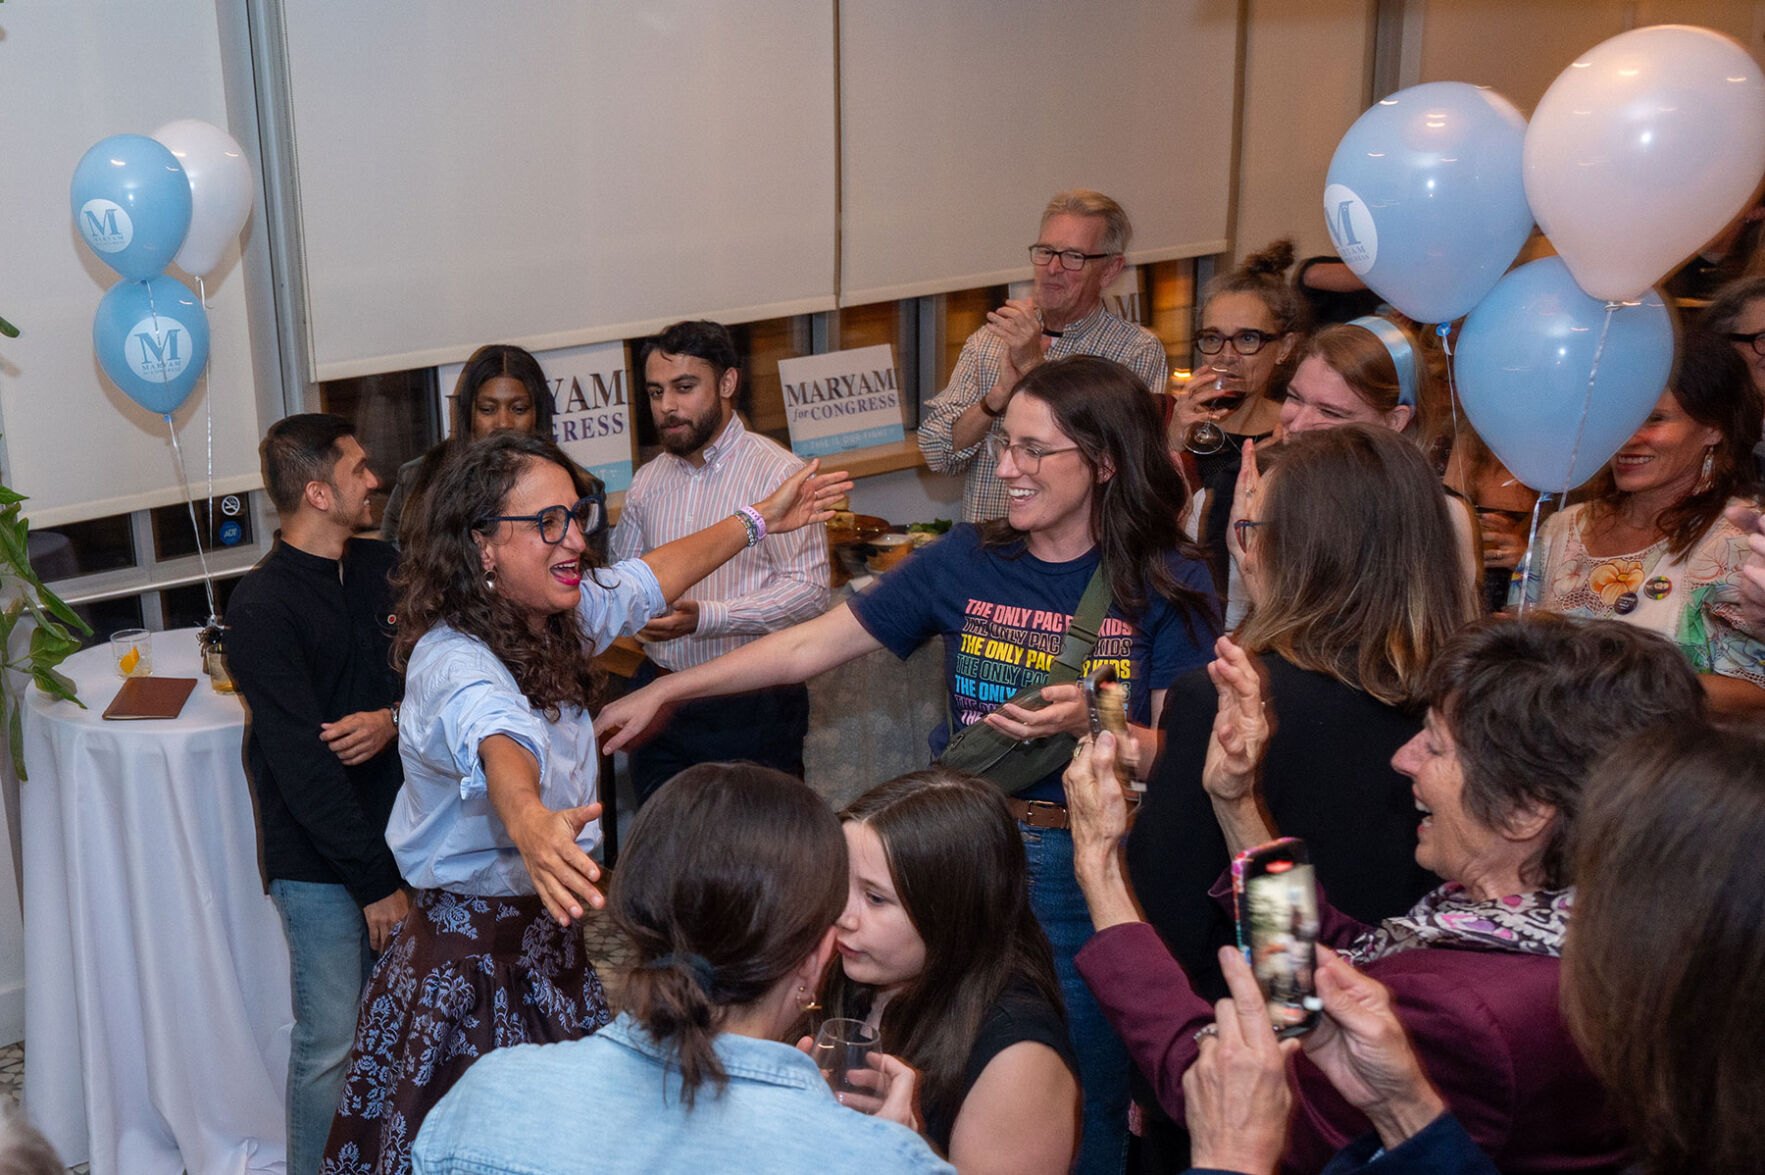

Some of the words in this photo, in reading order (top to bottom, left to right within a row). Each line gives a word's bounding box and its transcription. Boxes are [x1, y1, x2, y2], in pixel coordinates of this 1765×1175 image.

[83, 209, 121, 237] M
[134, 328, 182, 365] M
[784, 367, 896, 408] MARYAM
[792, 407, 809, 423] for
[811, 393, 897, 421] CONGRESS
[965, 598, 994, 619] THE
[992, 604, 1033, 628] ONLY
[1031, 610, 1063, 633] PAC
[960, 633, 986, 656] THE
[984, 639, 1025, 665] ONLY
[962, 616, 989, 637] THE
[989, 621, 1029, 646] ONLY
[1028, 631, 1061, 655] PAC
[1093, 637, 1133, 657] KIDS
[955, 674, 977, 698] THE
[956, 653, 980, 678] THE
[979, 660, 1022, 686] ONLY
